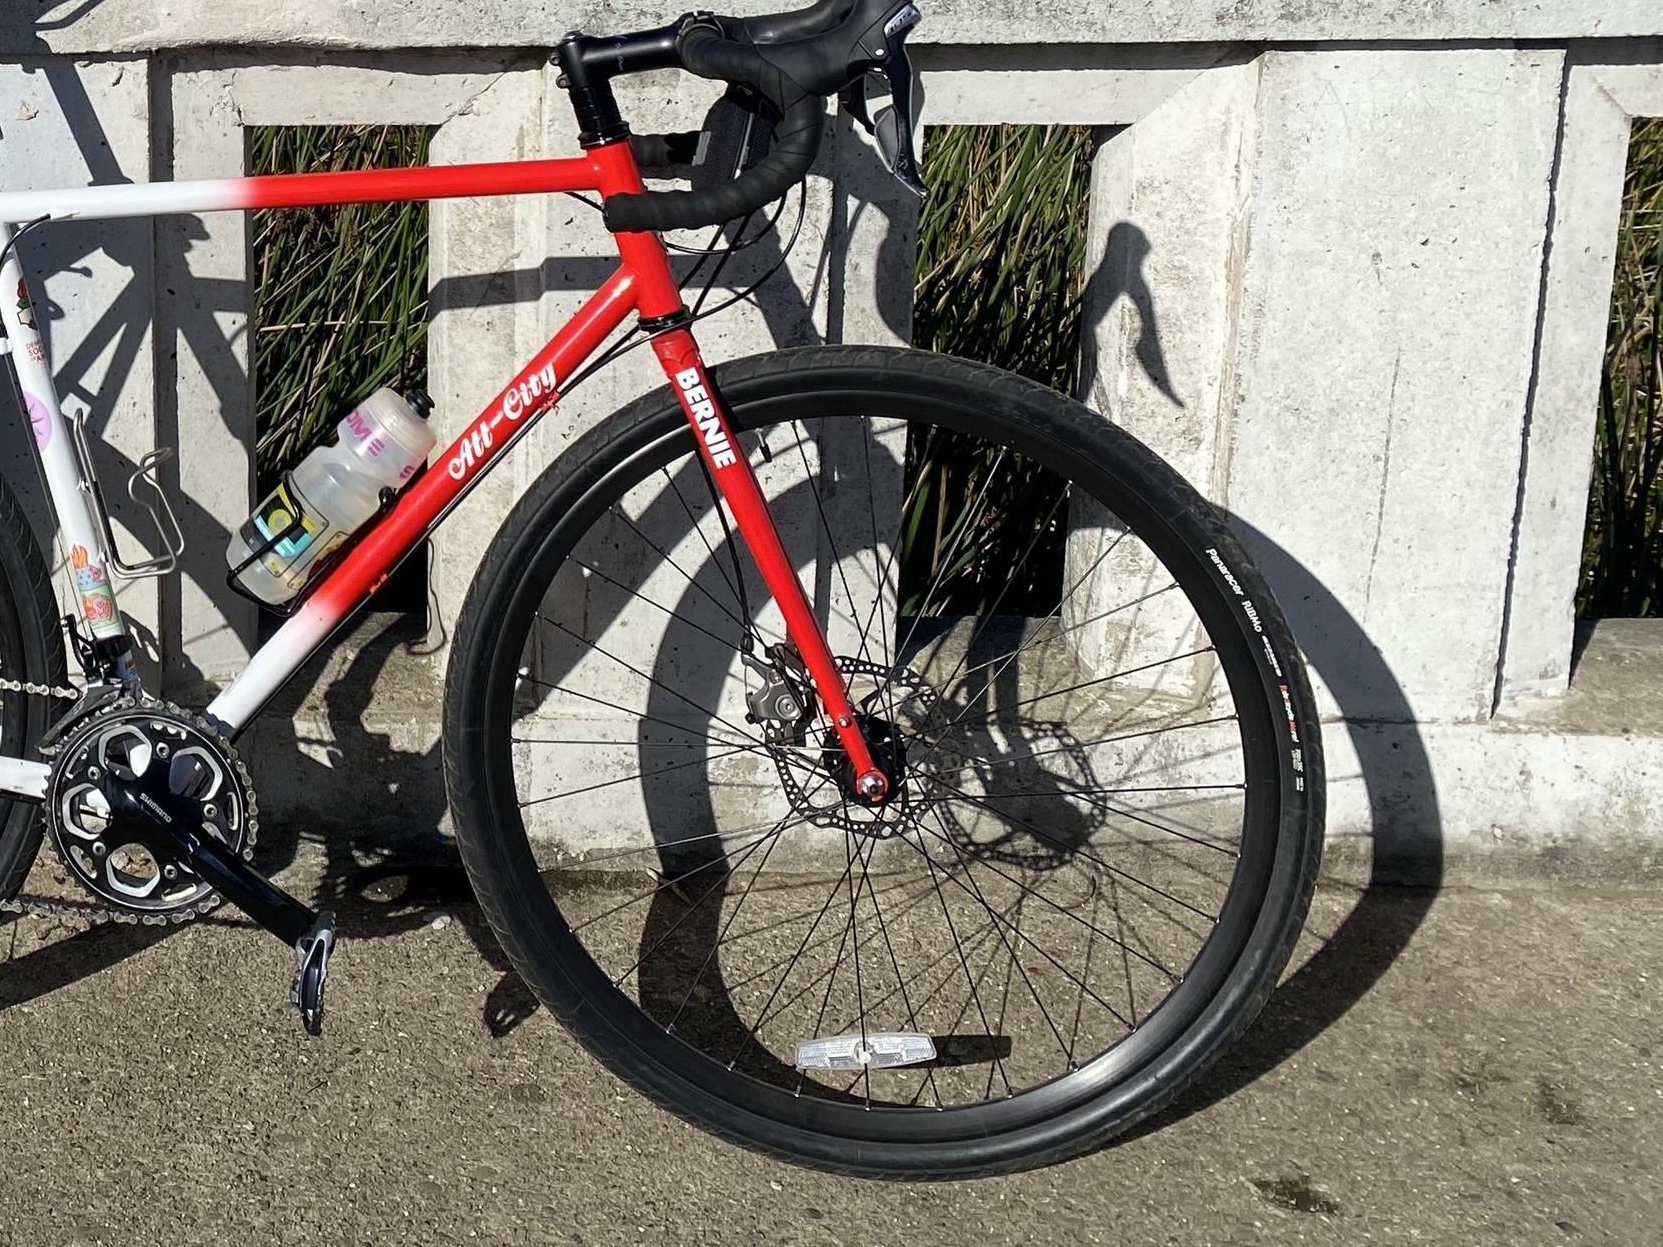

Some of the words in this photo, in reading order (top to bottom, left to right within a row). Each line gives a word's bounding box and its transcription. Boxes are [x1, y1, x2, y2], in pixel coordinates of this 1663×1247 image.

[675, 366, 738, 470] BERNIE
[1205, 548, 1244, 596] Panaracer
[139, 792, 172, 823] SHIMANO
